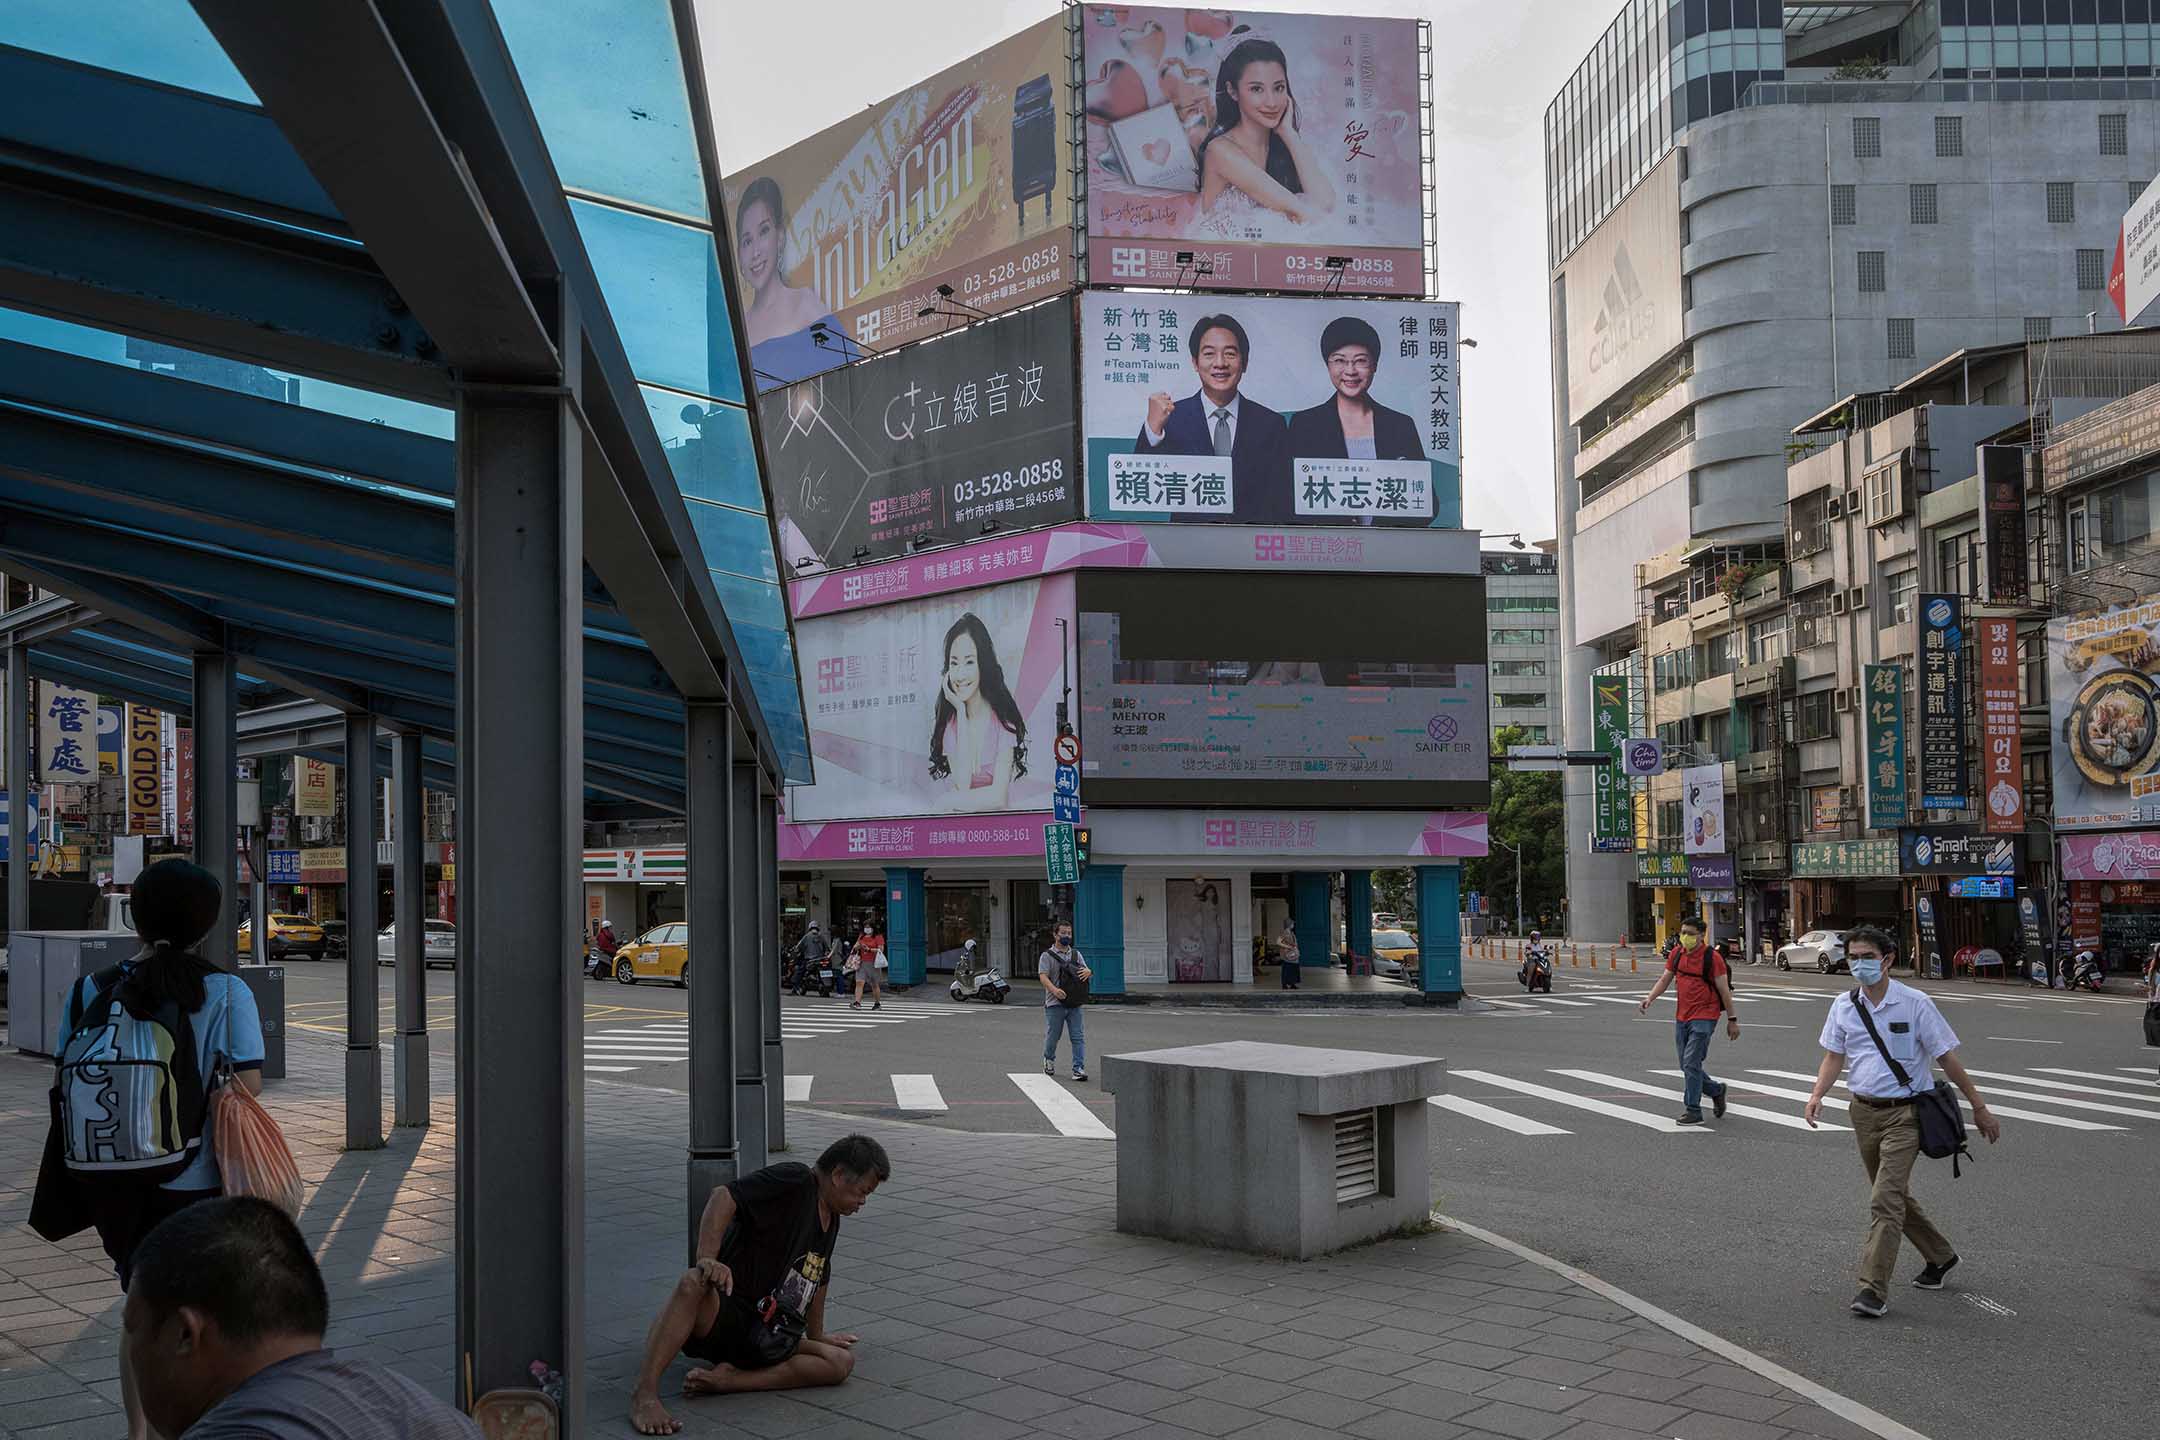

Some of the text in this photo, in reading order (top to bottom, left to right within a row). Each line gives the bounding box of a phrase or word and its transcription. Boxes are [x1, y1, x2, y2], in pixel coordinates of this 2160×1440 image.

[963, 246, 1060, 294] 03-528-0858
[1285, 256, 1393, 273] 03-5-0858
[1103, 307, 1178, 328] 新竹強
[1104, 332, 1179, 353] 台灣強
[1399, 316, 1418, 359] 律師
[1104, 358, 1180, 370] #TeamTaiwan
[1429, 318, 1450, 450] 陽明交大教授
[953, 459, 1064, 503] 03-528-0858
[1115, 470, 1227, 506] 賴清德
[1302, 475, 1409, 511] 林志潔
[888, 487, 933, 513] 聖宜診所
[955, 486, 1066, 523] 新竹市中華路二段456號
[1410, 480, 1425, 509] 博士
[1287, 535, 1364, 553] 聖宜診所
[923, 545, 1034, 583] 精雕細琢 完美妳型
[863, 566, 909, 591] 聖宜診所
[1989, 623, 2009, 665] 맛있
[1926, 630, 1946, 714] 創宇通訊
[1947, 650, 1957, 683] Smart
[48, 682, 92, 776] 管處
[1112, 712, 1166, 722] MENTOR
[1112, 724, 1149, 736] 女王波
[1871, 667, 1899, 790] 銘仁牙醫
[1415, 743, 1472, 753] SAINT EIR
[1634, 745, 1657, 758] Cha
[1634, 757, 1657, 768] time
[133, 746, 158, 809] GOLD
[1872, 792, 1904, 802] Dental
[1873, 802, 1903, 814] Clinic
[867, 826, 914, 845] 聖宜診所
[967, 828, 1031, 844] 0800-588-161
[1239, 819, 1318, 839] 聖宜診所
[1048, 825, 1063, 882] 請依號誌行止
[1060, 825, 1075, 881] 行人穿越路口
[1933, 836, 1969, 853] Smart
